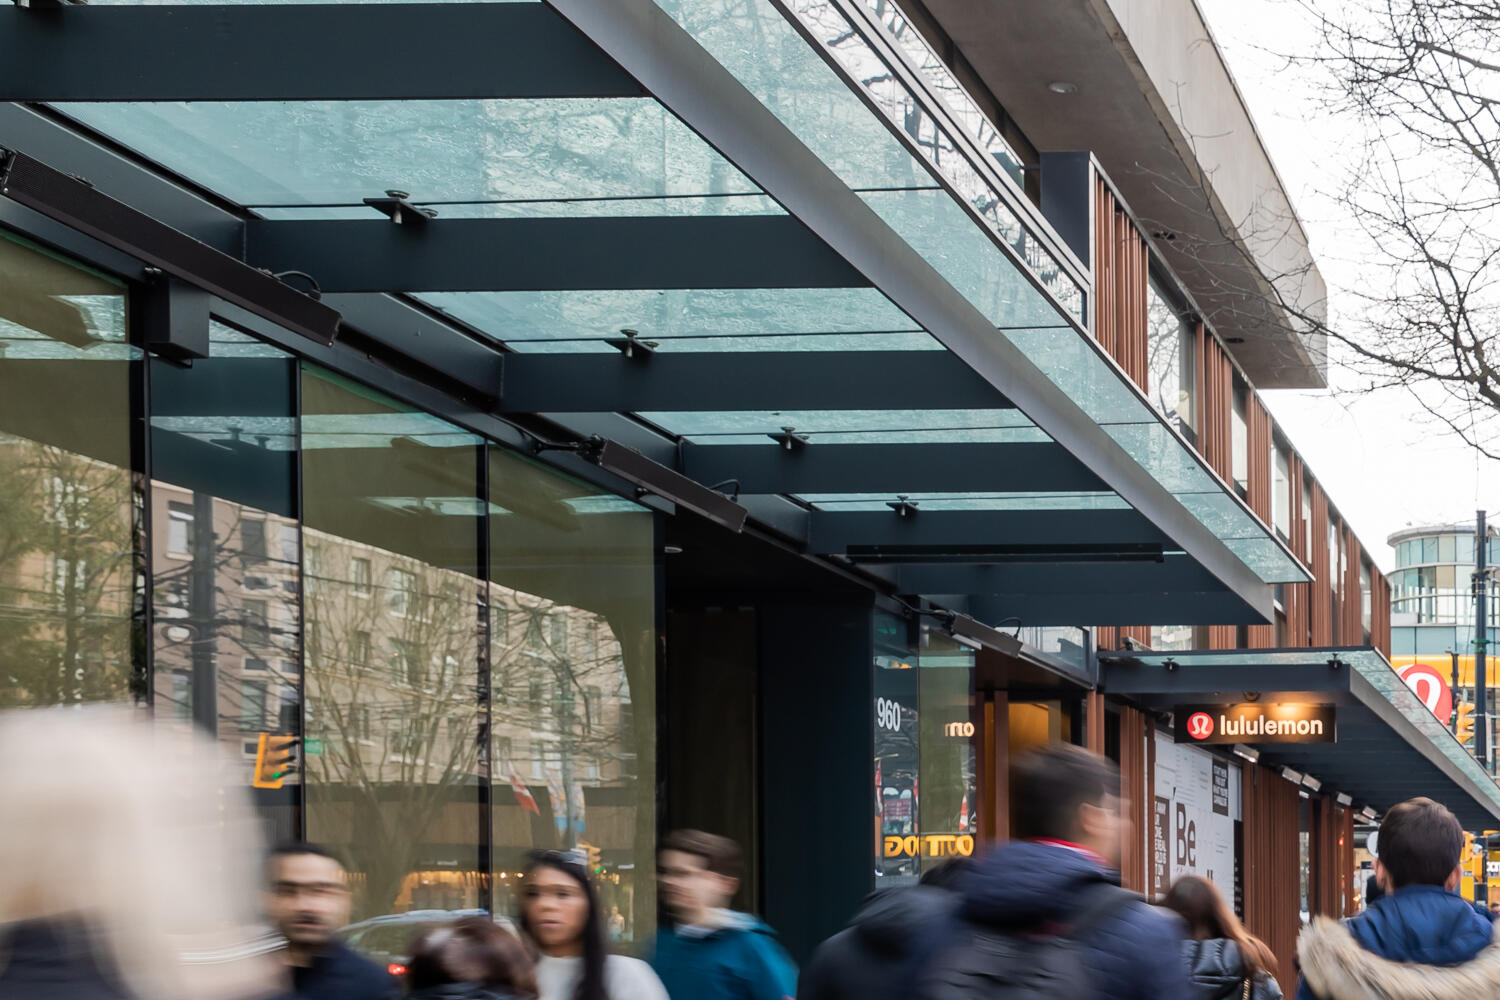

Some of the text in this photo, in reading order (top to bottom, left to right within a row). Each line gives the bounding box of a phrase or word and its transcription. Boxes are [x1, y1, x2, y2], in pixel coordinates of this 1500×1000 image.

[877, 697, 900, 732] 960
[1220, 715, 1323, 735] lululemon
[1176, 802, 1196, 867] Be
